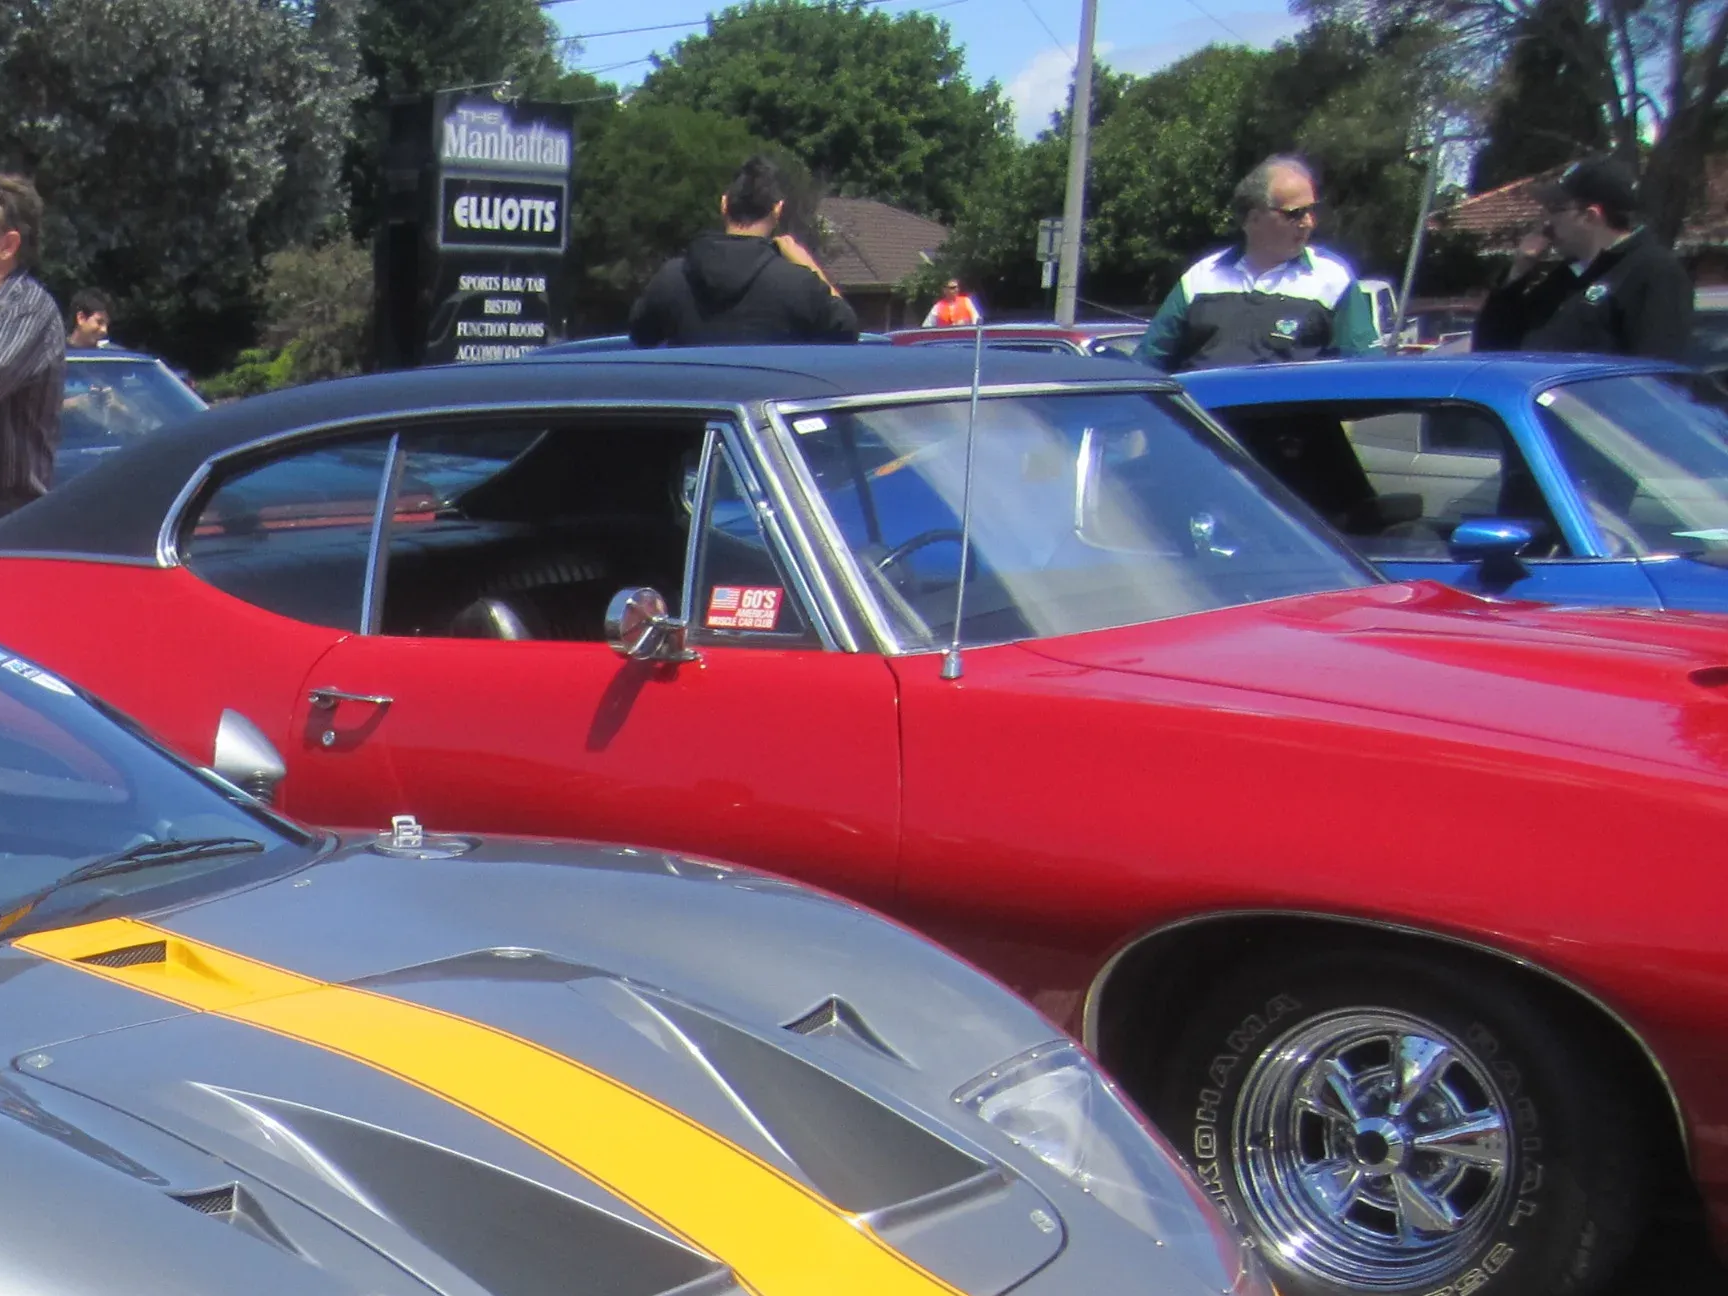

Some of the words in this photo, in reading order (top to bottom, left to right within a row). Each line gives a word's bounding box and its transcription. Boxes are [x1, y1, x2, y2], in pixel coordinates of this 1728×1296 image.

[457, 109, 500, 124] THE
[444, 121, 568, 166] Manhattan
[453, 196, 556, 232] ELLIOTTS
[458, 275, 500, 291] SPORTS
[502, 277, 546, 292] BAR/TAB
[484, 299, 522, 315] BISTRO
[457, 322, 508, 337] FUNCTION
[509, 322, 545, 337] ROOMS
[741, 589, 776, 609] 60'S
[735, 608, 775, 619] AMERICAN
[707, 616, 737, 626] MUSCLE
[738, 616, 753, 627] CAR
[753, 618, 774, 628] CLUB
